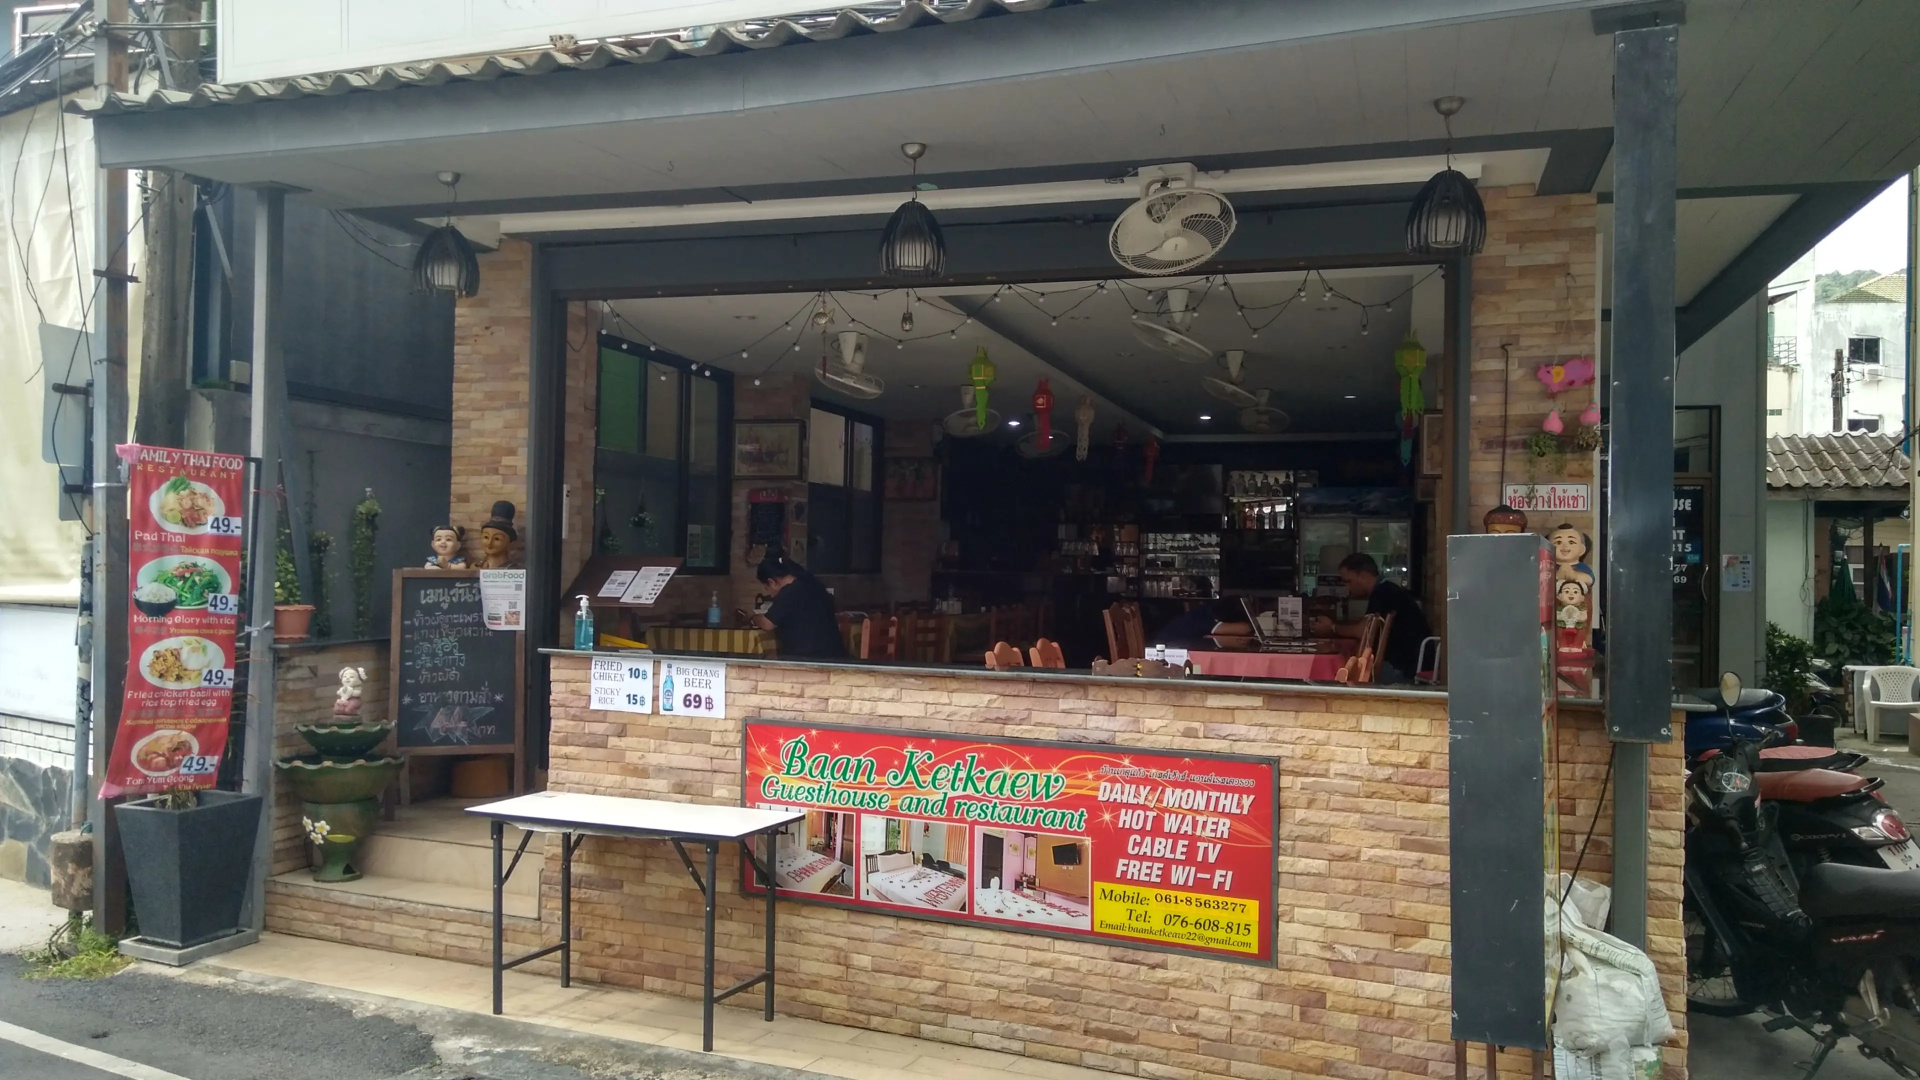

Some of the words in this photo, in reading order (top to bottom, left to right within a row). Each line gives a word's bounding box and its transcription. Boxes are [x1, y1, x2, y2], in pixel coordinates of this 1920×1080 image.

[139, 449, 180, 465] AMILY
[182, 452, 210, 468] THAI
[212, 456, 243, 470] FOOD
[136, 464, 238, 480] RESTAURANT
[134, 531, 158, 542] Pad
[160, 532, 186, 543] Thai
[482, 571, 525, 580] GrabFood
[133, 615, 173, 625] Morning
[174, 616, 200, 625] Glory
[202, 616, 218, 625] with
[219, 617, 236, 625] rice
[593, 659, 623, 671] FRIED
[592, 672, 625, 683] CHIKEN
[675, 667, 691, 677] BIG
[692, 668, 720, 679] CHANG
[684, 677, 712, 690] BEER
[127, 690, 153, 699] Fried
[154, 689, 189, 698] chicken
[190, 689, 211, 698] basil
[212, 688, 231, 697] with
[594, 686, 622, 697] STICKY
[141, 699, 159, 707] rice
[160, 698, 177, 708] top
[178, 698, 200, 706] fried
[201, 698, 217, 707] egg
[598, 696, 615, 706] RICE
[780, 735, 877, 785] Baan
[886, 749, 1067, 804] Ketkaew
[126, 776, 145, 786] Tom
[147, 776, 165, 784] Yum
[167, 775, 195, 784] Goong
[760, 773, 890, 811] Guesthouse
[897, 791, 948, 818] and
[952, 800, 1089, 832] restaurant
[1117, 808, 1158, 832] HOT
[1163, 812, 1232, 840] WATER
[1127, 834, 1189, 861] CABLE
[1196, 841, 1222, 864] TV
[1115, 858, 1165, 884] FREE
[1170, 864, 1234, 892] WI-FI
[1098, 887, 1150, 906] Mobile:
[1154, 892, 1247, 914] 061-8563277
[1099, 920, 1127, 932] Email:
[1126, 908, 1152, 924] Tel:
[1163, 913, 1252, 937] 076-608-815
